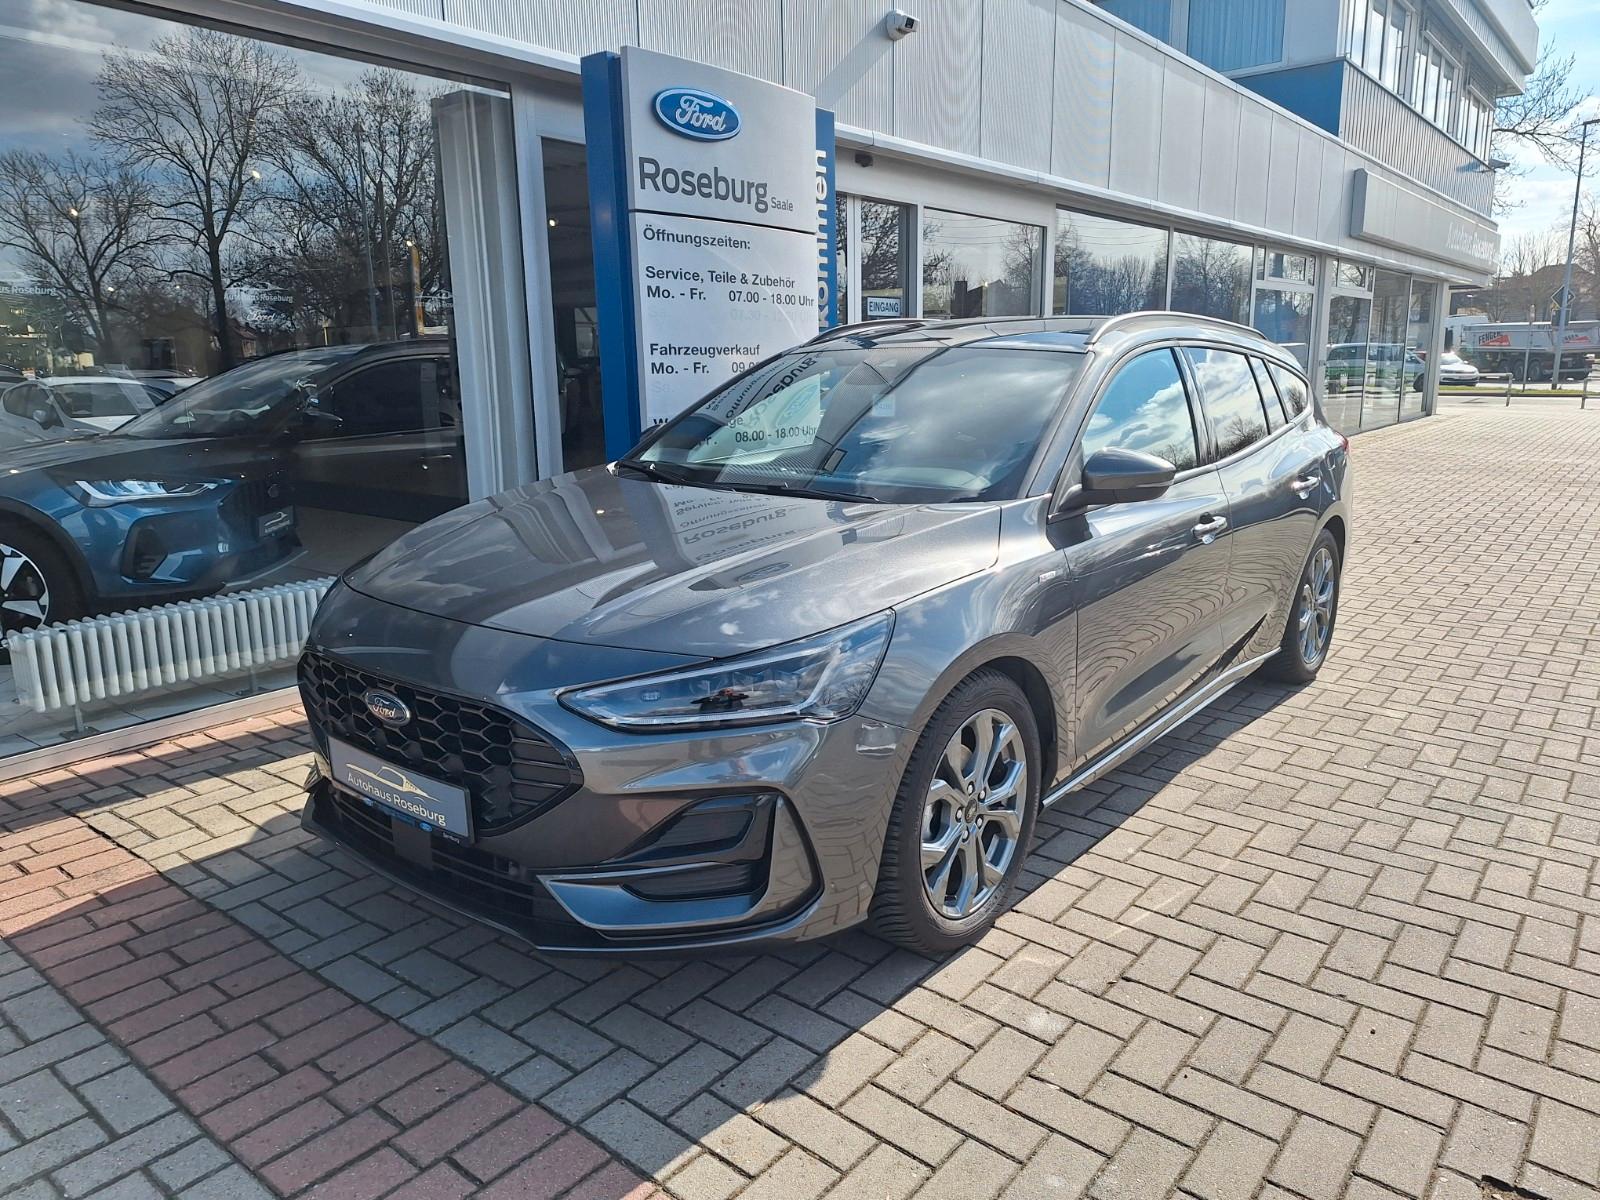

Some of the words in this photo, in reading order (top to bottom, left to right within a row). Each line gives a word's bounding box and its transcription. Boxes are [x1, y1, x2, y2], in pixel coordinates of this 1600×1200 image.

[675, 95, 727, 132] Ford
[638, 156, 769, 214] Roseburg
[770, 196, 794, 212] Saale
[643, 223, 751, 250] Öffnungszeiten:
[645, 265, 704, 284] Service,
[707, 270, 737, 284] Teile
[740, 272, 749, 285] &
[751, 273, 796, 289] Zubehör
[646, 285, 675, 299] Mo.
[689, 287, 706, 300] Fr.
[728, 290, 760, 304] 07.00
[770, 293, 796, 306] 18.00
[798, 295, 815, 307] Uhr
[868, 301, 899, 313] EINGANG
[650, 343, 760, 359] Fahrzeugverkauf
[651, 362, 679, 375] Mo.
[693, 362, 710, 374] Fr.
[735, 430, 765, 443] 08.00
[775, 426, 800, 440] 18.00
[373, 696, 396, 719] Ford
[347, 772, 392, 803] Autohaus
[393, 793, 446, 828] Roseburg
